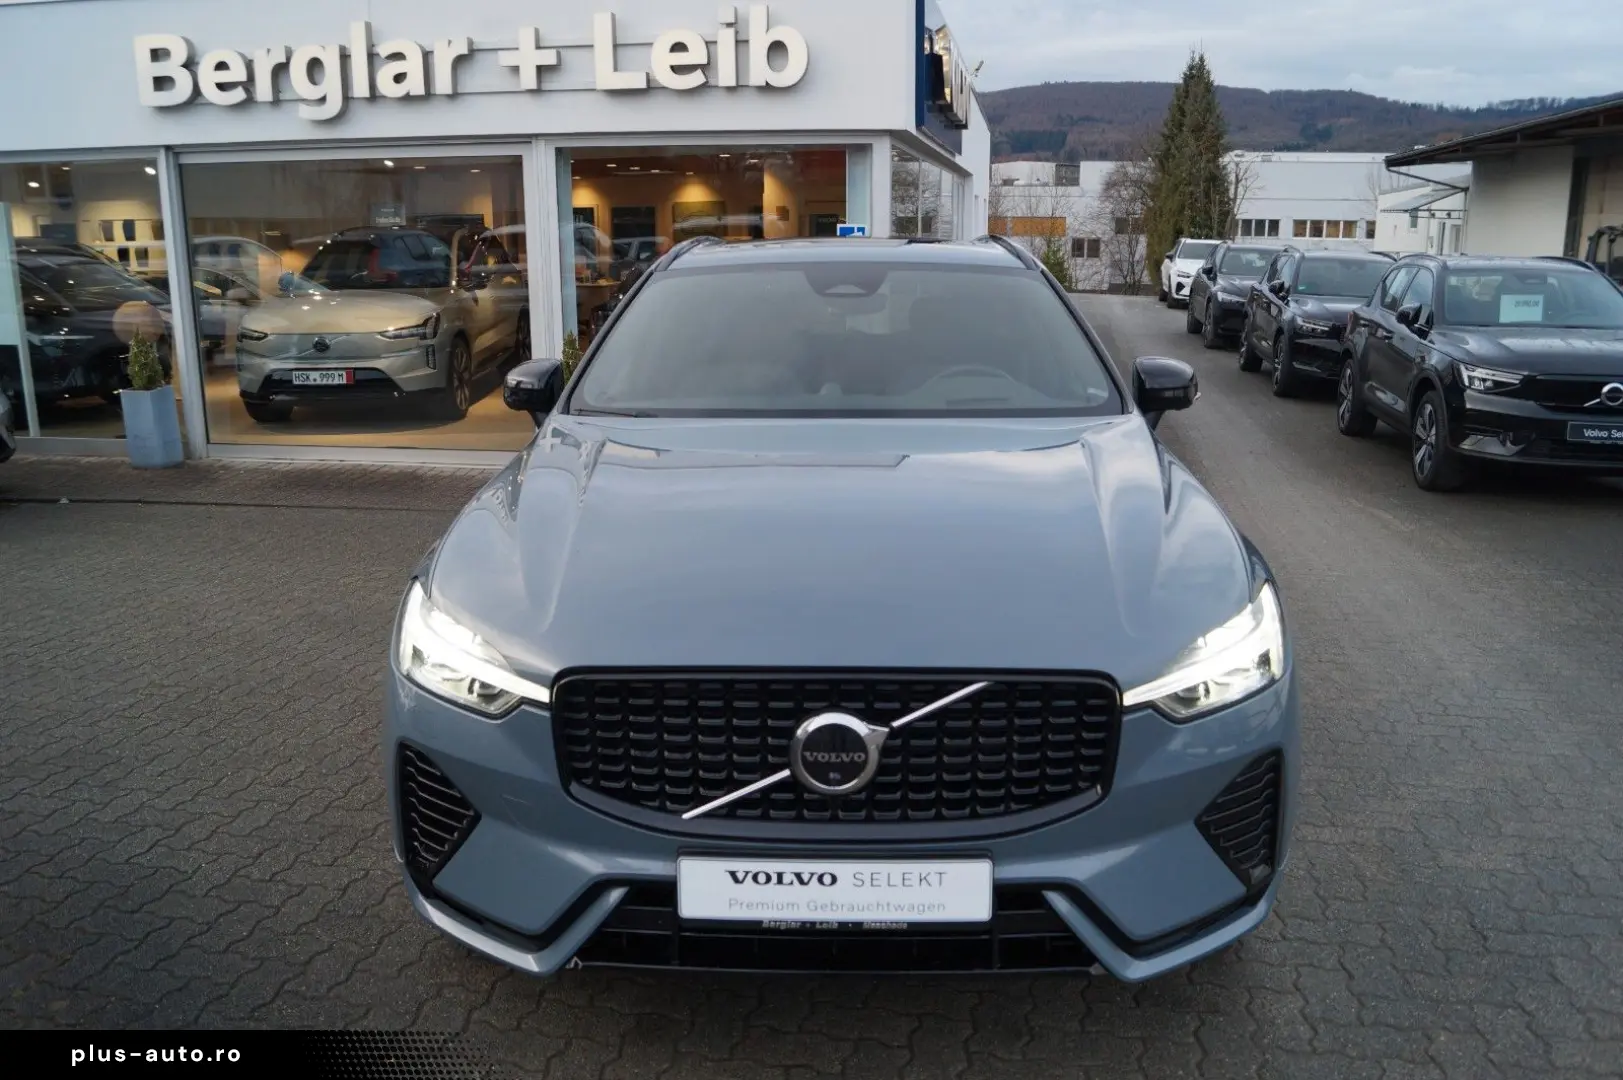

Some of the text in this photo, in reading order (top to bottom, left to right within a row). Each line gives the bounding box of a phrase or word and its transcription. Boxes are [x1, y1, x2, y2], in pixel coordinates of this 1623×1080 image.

[131, 3, 811, 122] Berglar + Leib
[294, 372, 311, 383] HSK
[1583, 428, 1608, 437] Volvo
[803, 751, 866, 763] VOLVO
[724, 869, 949, 889] VOLVO SELEKT
[728, 898, 947, 915] Premium Gebrauchtwagen
